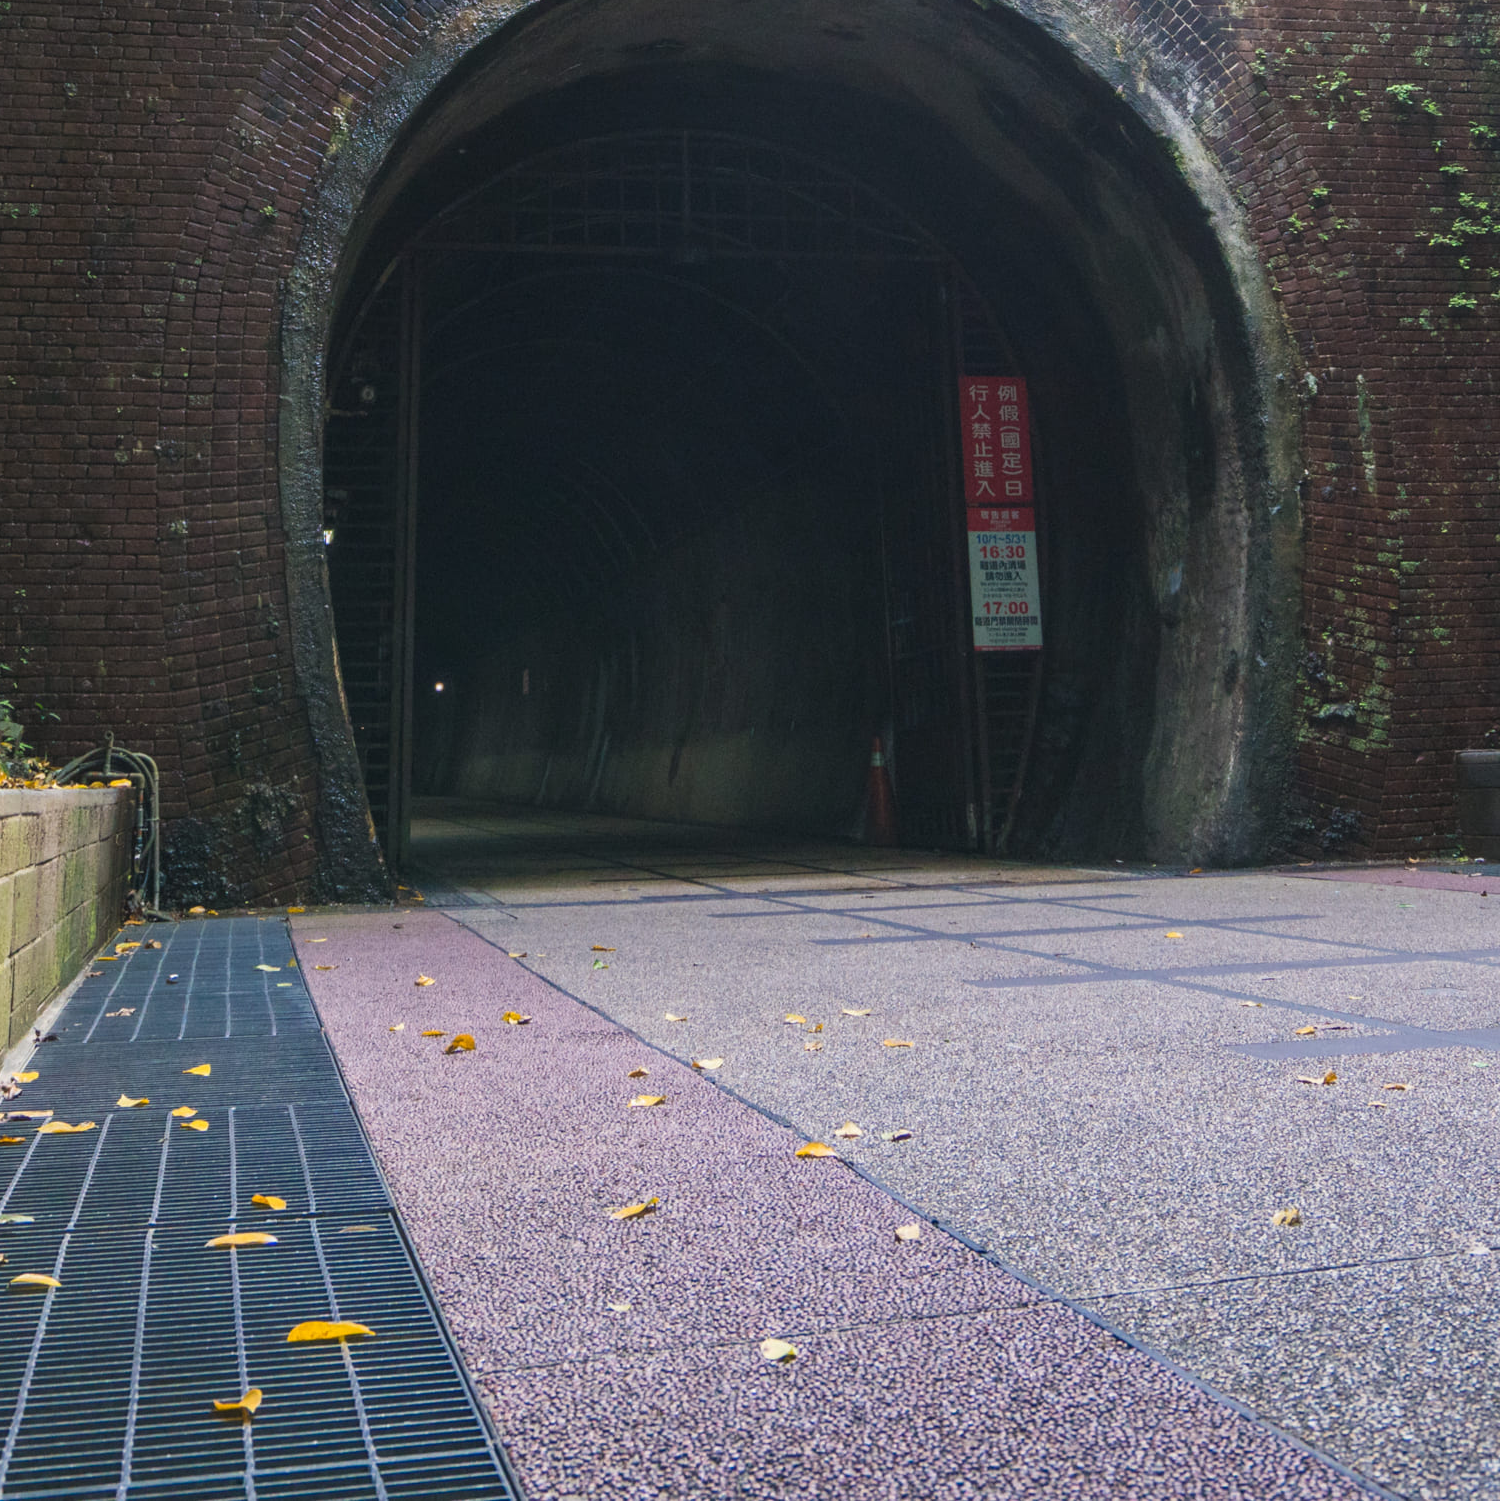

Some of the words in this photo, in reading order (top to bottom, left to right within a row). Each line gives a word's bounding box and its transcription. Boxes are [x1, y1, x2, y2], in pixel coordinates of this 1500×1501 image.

[968, 384, 996, 497] 行人禁止進入
[976, 533, 1027, 544] 10/1~5/31
[979, 545, 1026, 559] 16:30
[982, 601, 1029, 615] 17:00
